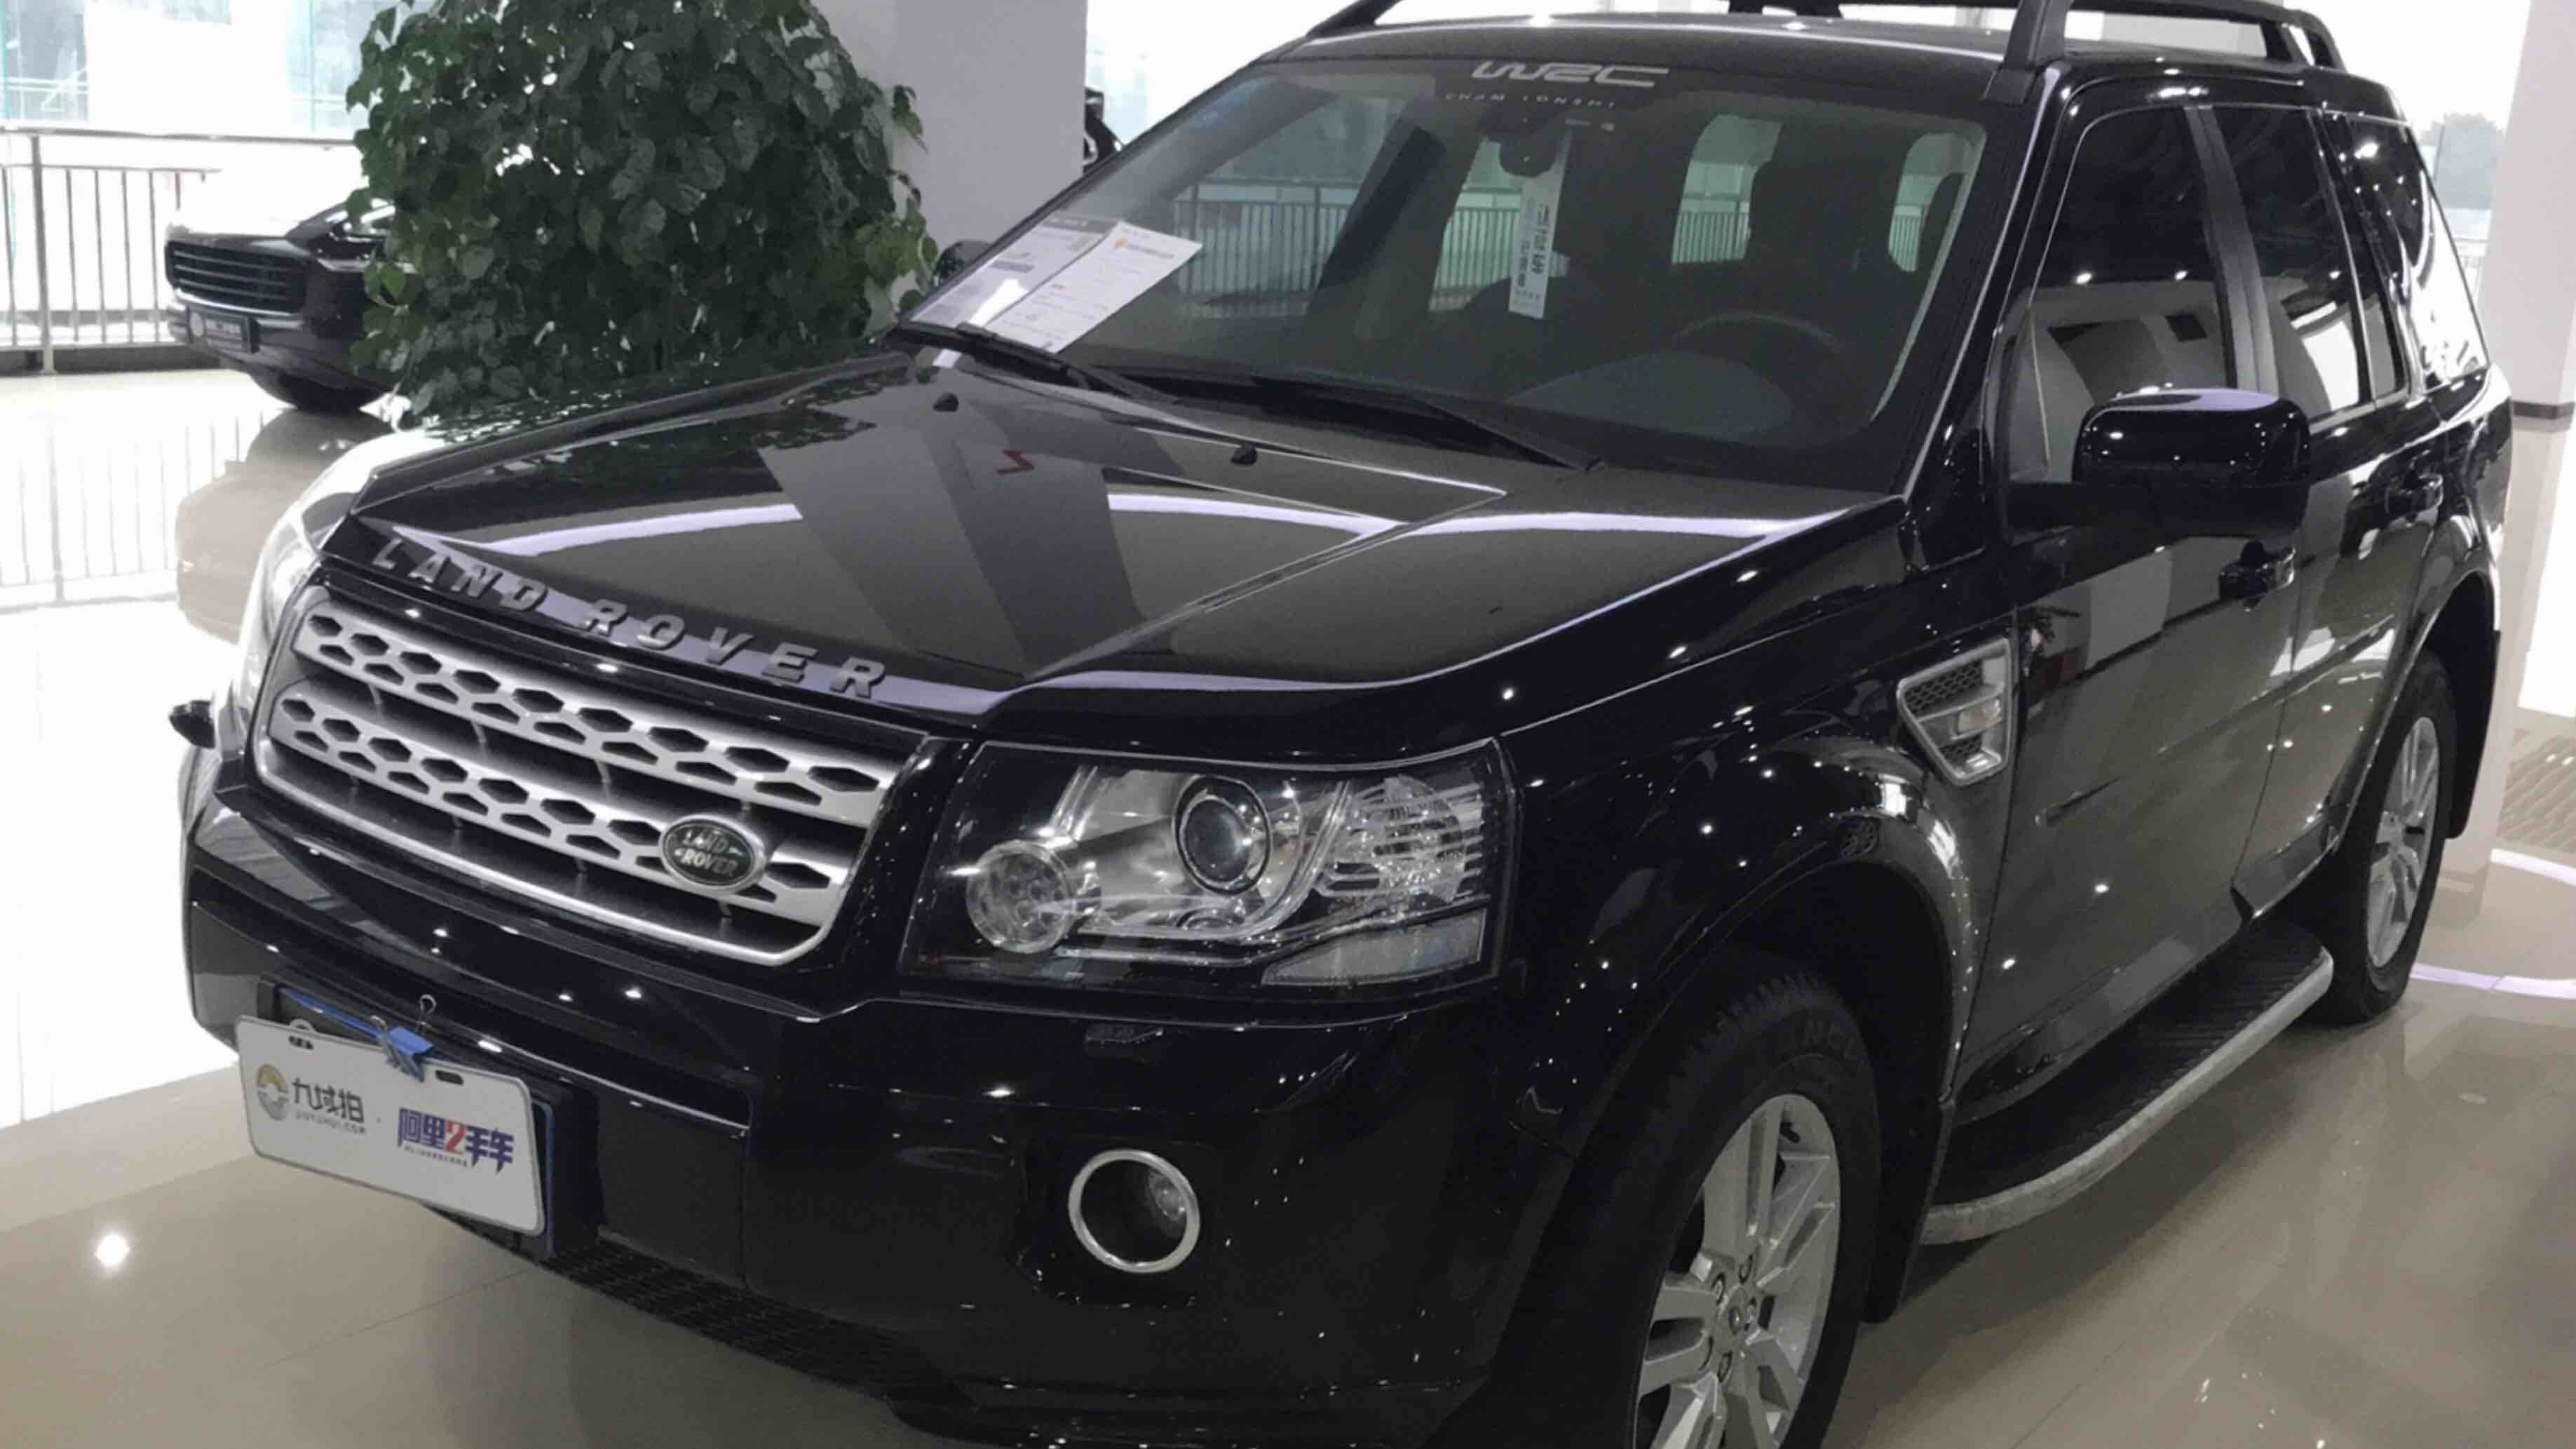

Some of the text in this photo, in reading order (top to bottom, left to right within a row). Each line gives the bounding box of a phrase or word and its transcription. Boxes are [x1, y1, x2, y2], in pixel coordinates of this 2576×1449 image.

[372, 537, 886, 699] LAND ROVER
[292, 1077, 365, 1123] 九域拍
